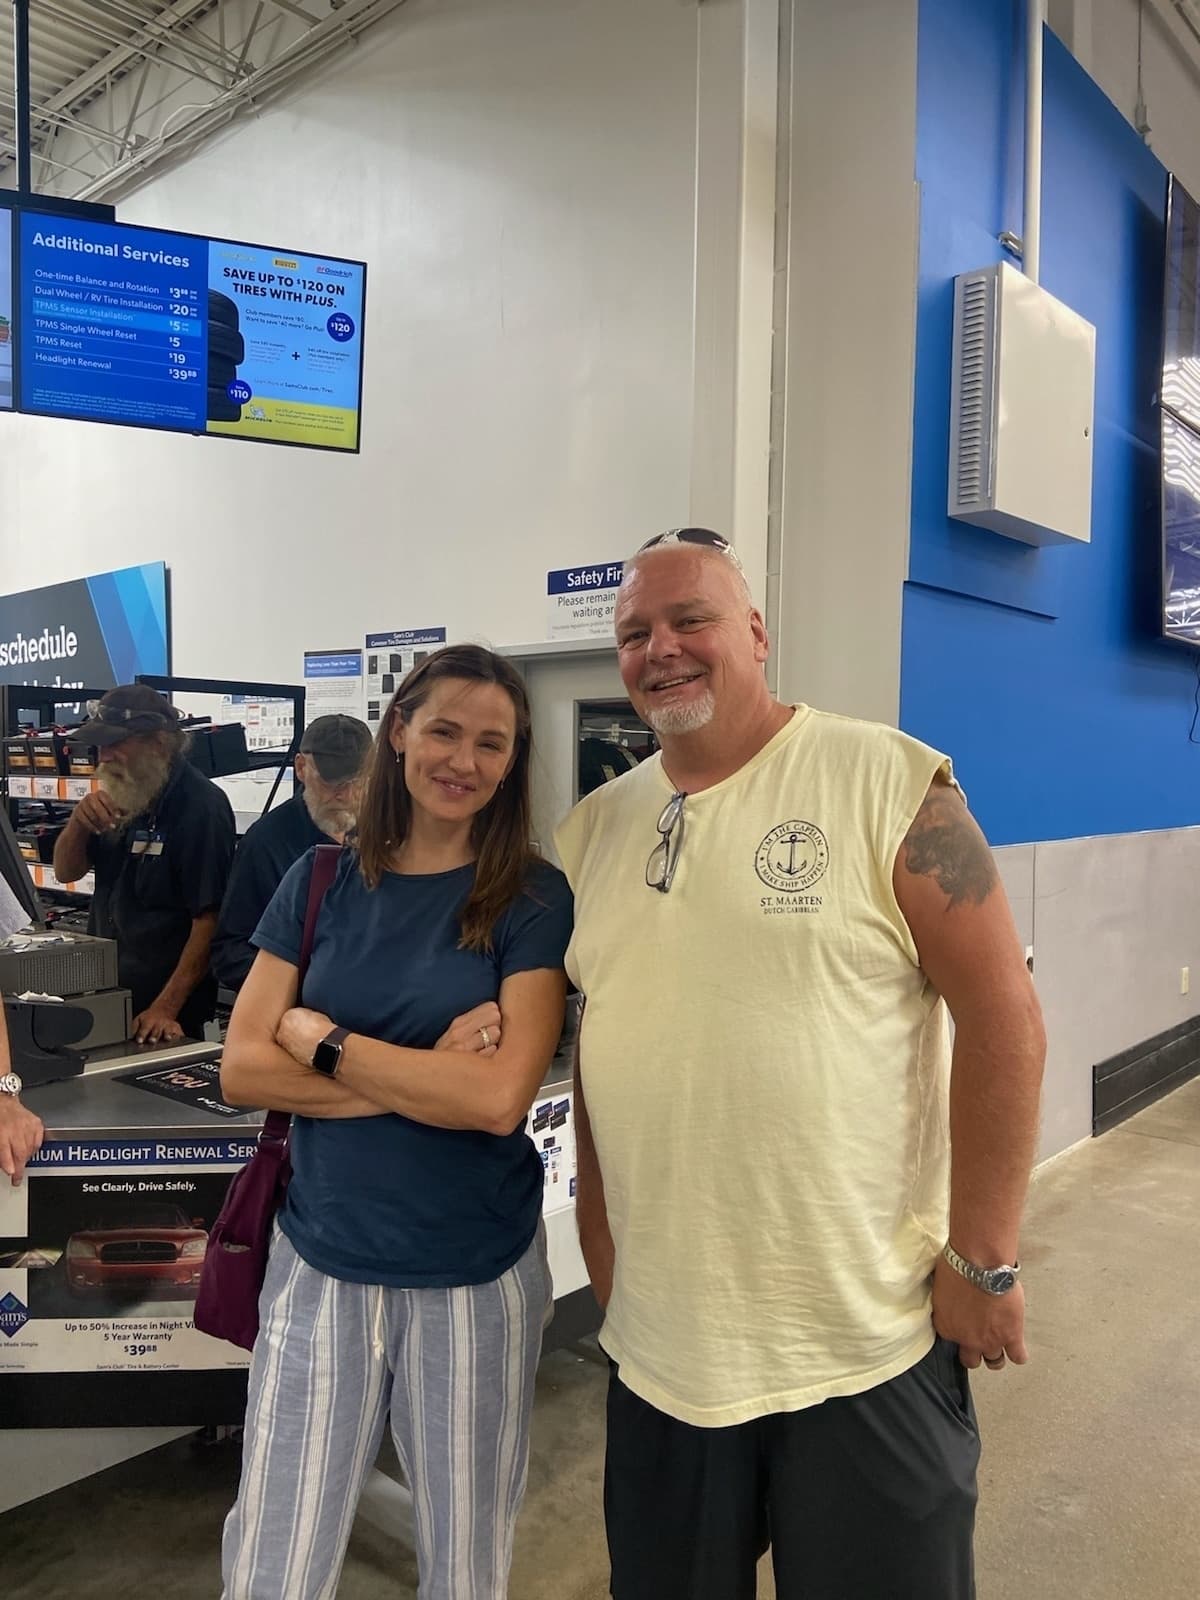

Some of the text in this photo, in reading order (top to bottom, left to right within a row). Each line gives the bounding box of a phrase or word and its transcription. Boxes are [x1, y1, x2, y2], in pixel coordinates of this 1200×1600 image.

[33, 233, 190, 268] Additional Services
[35, 269, 74, 282] One-time
[76, 275, 107, 287] Balance
[109, 280, 124, 289] and
[126, 282, 159, 294] Rotation
[224, 268, 344, 295] SAVE UP TO $120 ON
[35, 286, 54, 295] Dual
[56, 289, 82, 300] Wheel
[91, 294, 102, 302] RV
[104, 295, 118, 305] Tire
[120, 298, 163, 311] Installation
[170, 304, 188, 316] $20
[233, 283, 337, 308] TIRES WITH PLUS.
[35, 301, 59, 312] TPMS
[60, 302, 88, 315] Sensor
[36, 319, 181, 347] TPMS Single Wheel Reset $5
[331, 322, 350, 333] $120
[36, 336, 186, 364] TPMS Reset $19
[35, 353, 76, 365] Headlight
[78, 358, 111, 369] Renewal
[230, 390, 249, 399] $110
[567, 570, 603, 587] Safety
[558, 592, 616, 607] Please remain
[573, 606, 603, 618] waiting
[0, 626, 77, 666] schedule
[762, 824, 824, 851] I'M THE CAPTAIN
[762, 870, 779, 887] MAKE
[801, 862, 824, 886] HAPPEN
[760, 896, 822, 907] ST. MAARTEN
[161, 1072, 211, 1089] YOU
[68, 1146, 151, 1161] HEADLIGHT
[156, 1145, 223, 1160] RENEWAL
[83, 1182, 196, 1194] See Clearly. Drive Safely.
[65, 1323, 77, 1332] Up
[90, 1323, 110, 1331] 50%
[112, 1322, 148, 1330] Increase
[150, 1322, 157, 1330] in
[160, 1322, 183, 1331] Night
[104, 1333, 173, 1342] 5 Year Warranty
